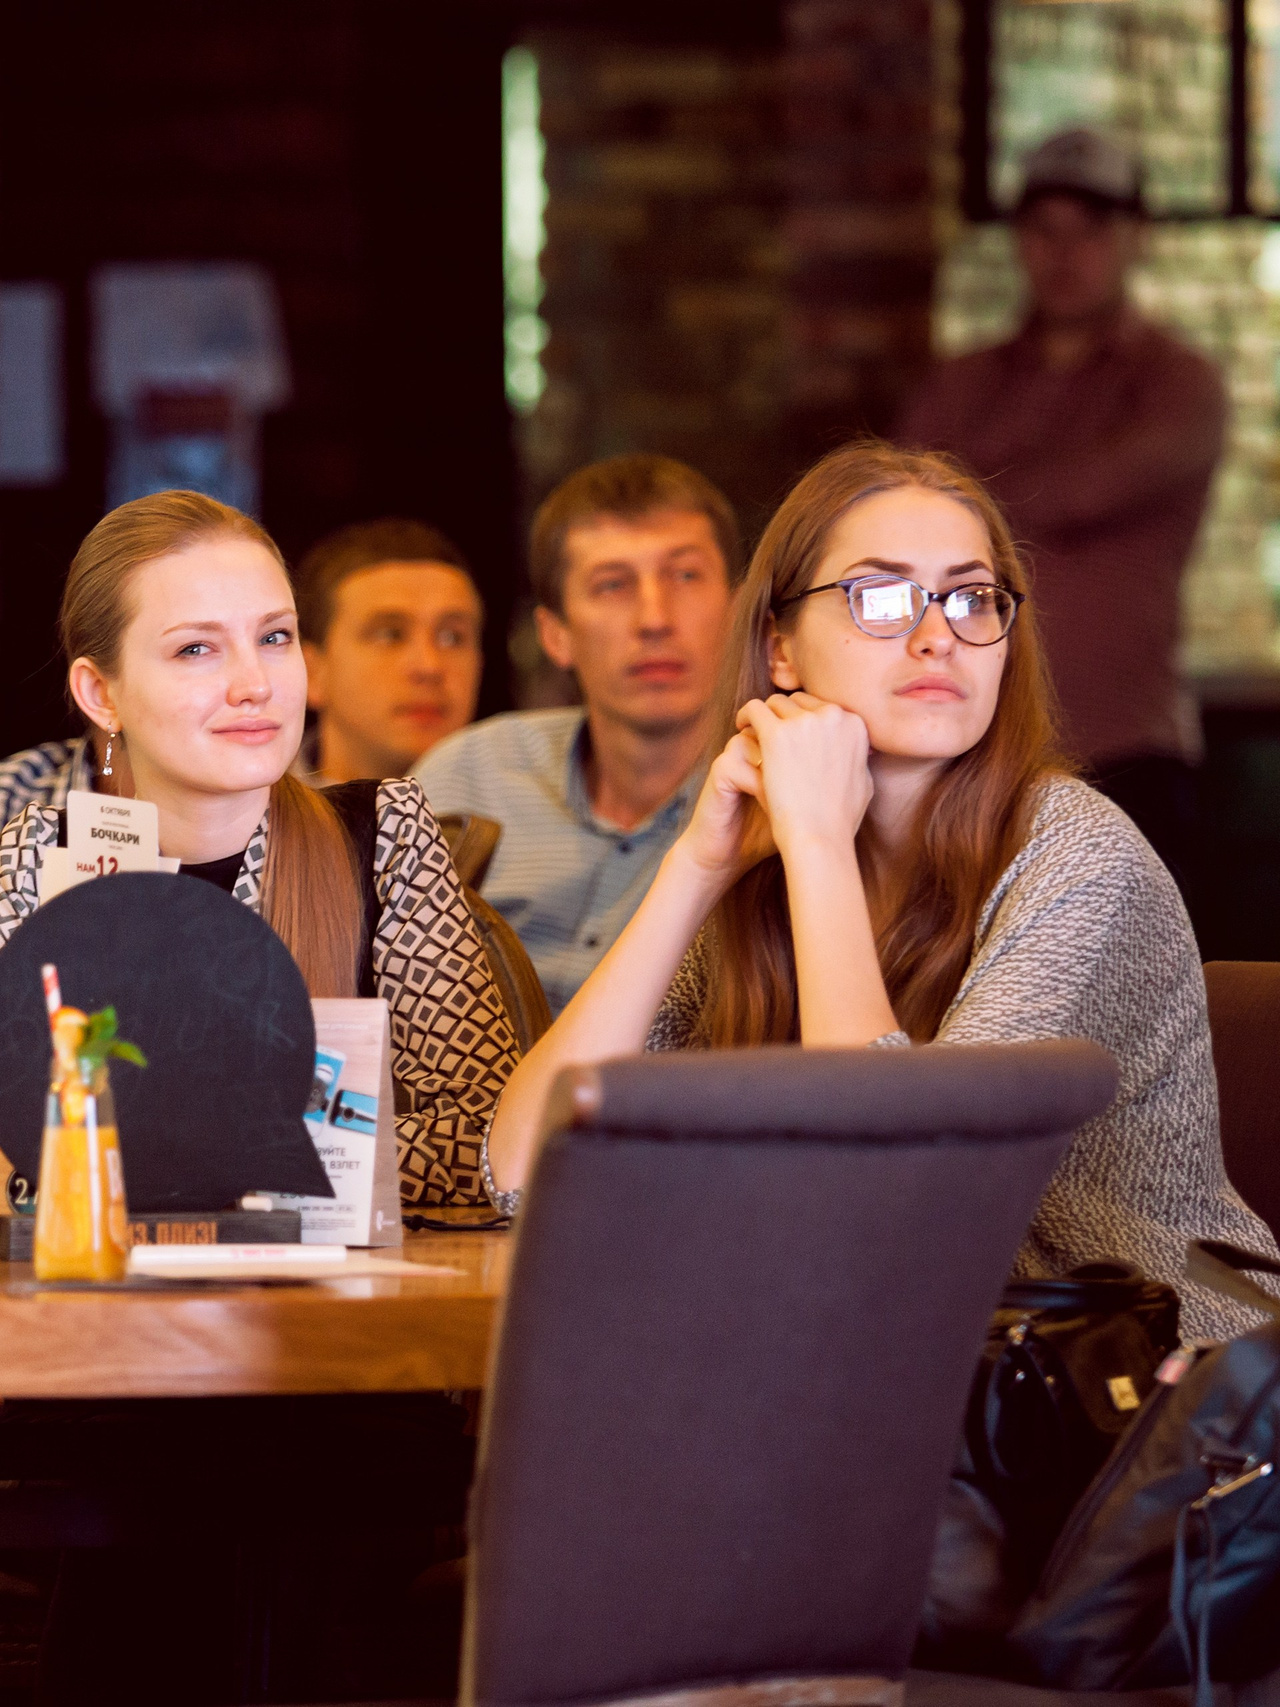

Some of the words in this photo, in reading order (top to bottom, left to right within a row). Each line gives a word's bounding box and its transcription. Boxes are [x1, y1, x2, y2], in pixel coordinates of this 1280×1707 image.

[91, 827, 140, 846] БОЧКАРИ
[76, 862, 96, 874] НАМ
[96, 855, 119, 877] 12
